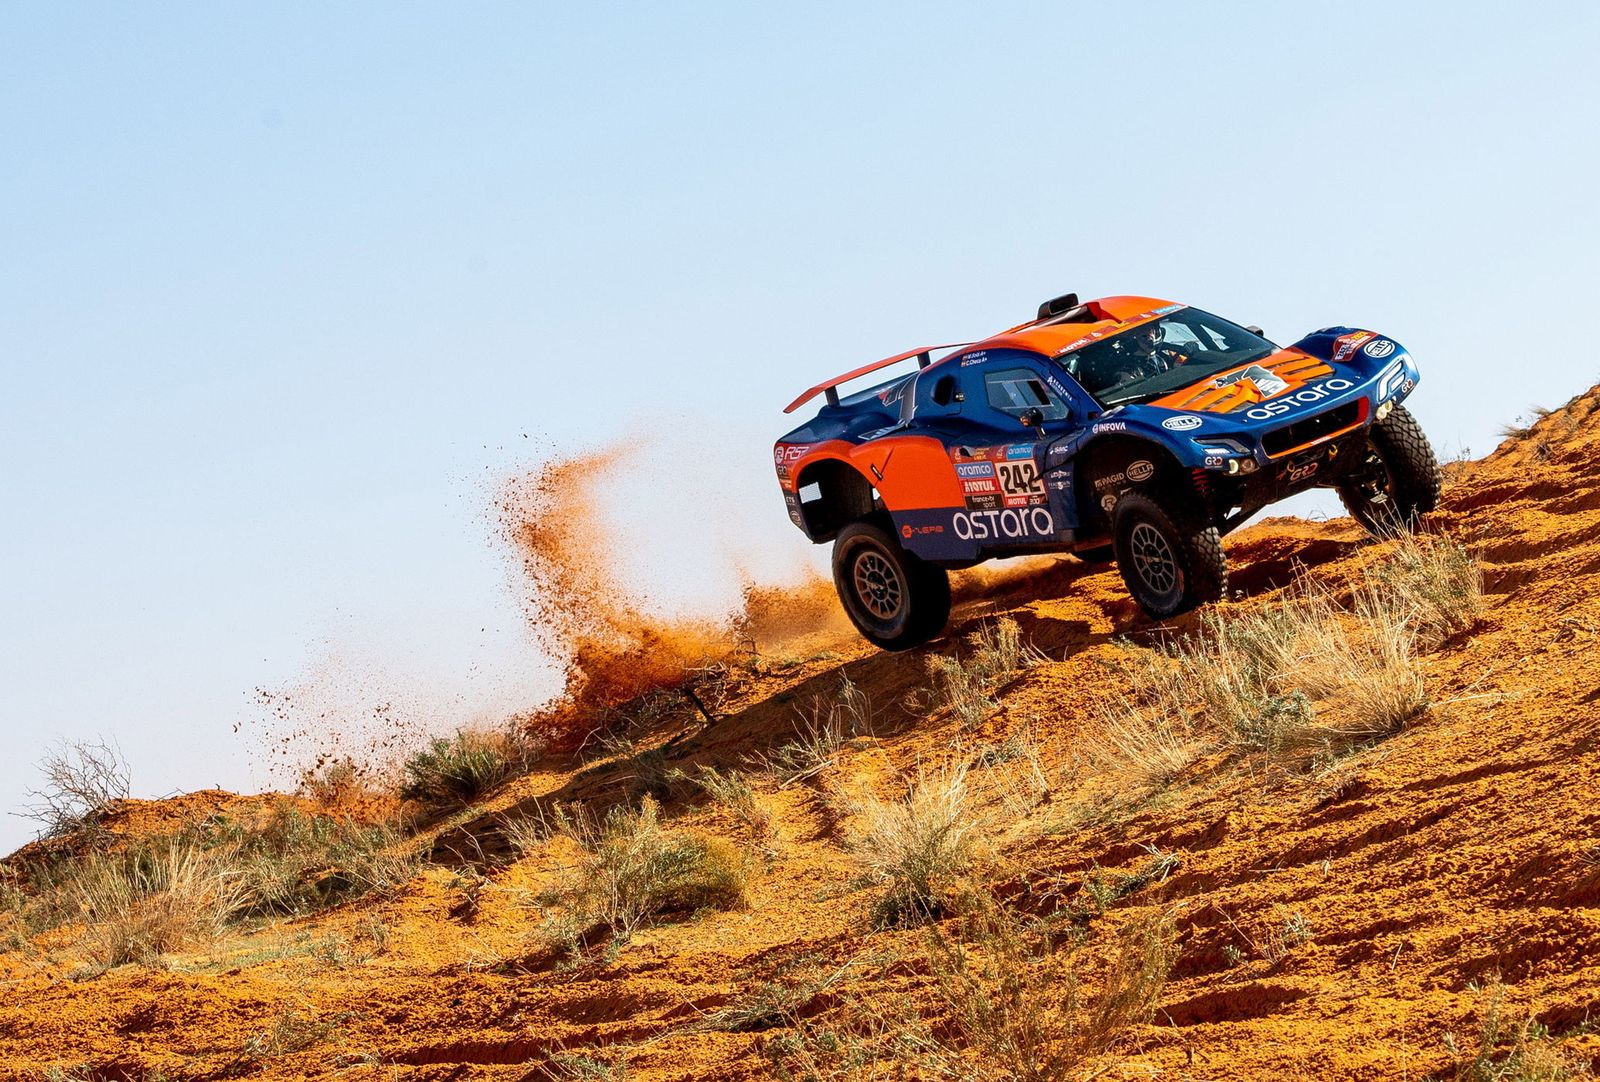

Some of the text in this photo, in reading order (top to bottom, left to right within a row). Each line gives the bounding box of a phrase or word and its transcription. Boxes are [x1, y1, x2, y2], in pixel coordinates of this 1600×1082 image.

[1247, 378, 1354, 420] astara
[1099, 422, 1126, 432] INFOVA
[1008, 447, 1032, 455] aramco
[958, 464, 991, 476] aramco
[1128, 463, 1154, 477] HELLA
[1000, 463, 1041, 495] 242
[1102, 472, 1125, 485] PAGID
[965, 480, 995, 492] MOTUL
[953, 507, 1054, 540] astara
